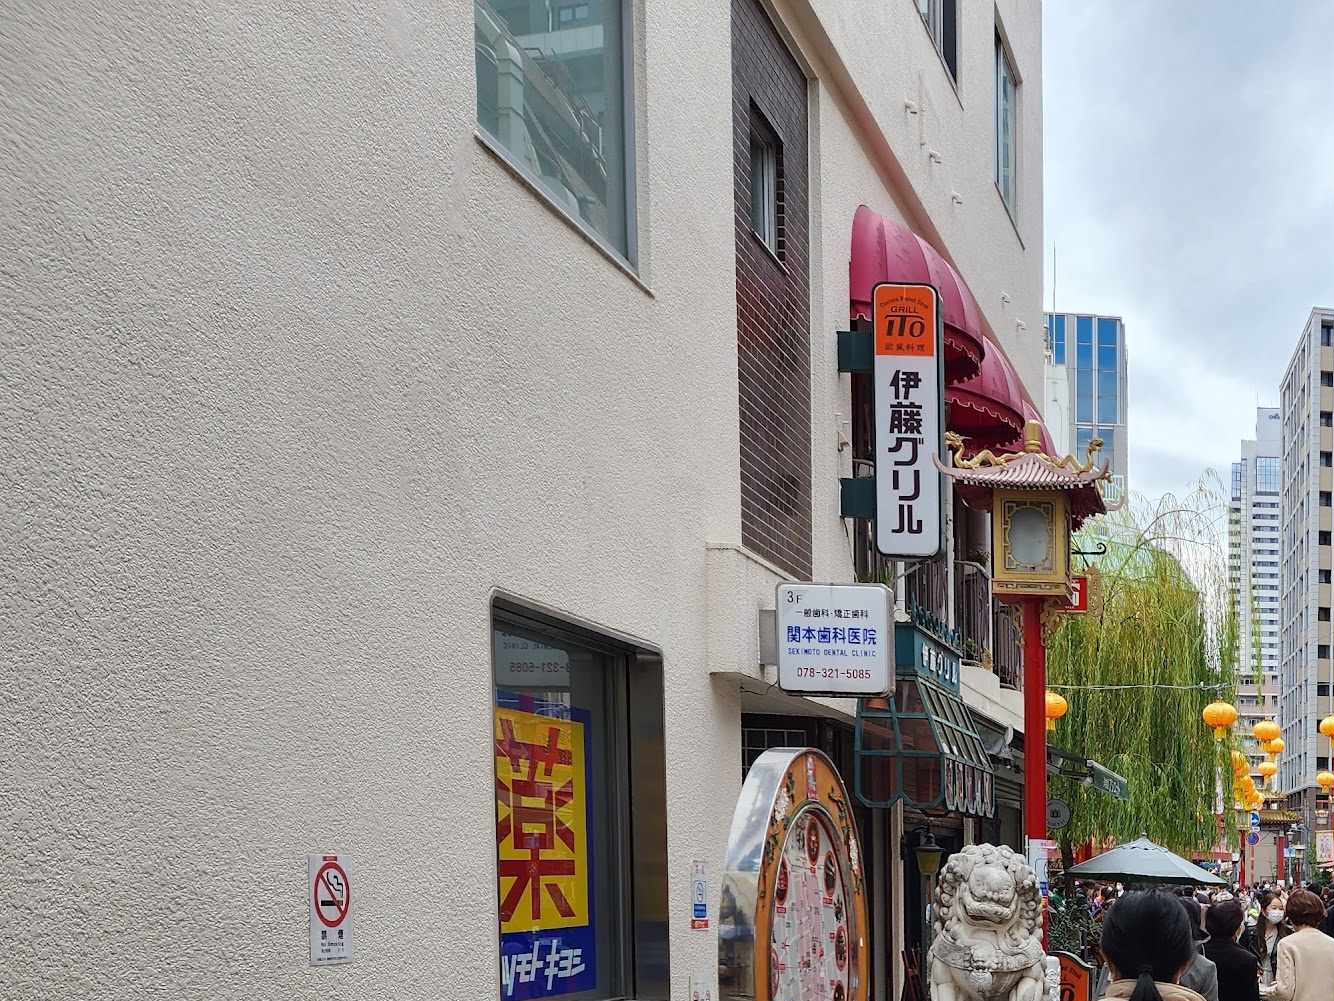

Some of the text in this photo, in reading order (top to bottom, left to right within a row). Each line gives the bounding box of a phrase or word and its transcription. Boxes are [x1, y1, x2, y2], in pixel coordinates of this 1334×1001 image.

[890, 305, 919, 314] GRILL
[884, 342, 926, 352] 欧風料理
[887, 368, 924, 536] 伊藤グリル
[787, 590, 803, 604] 3F
[787, 625, 877, 645] 関本歯科医院
[787, 647, 876, 658] SEKIMOTO DENTAL CLINIC
[796, 667, 871, 679] 078-321-5085
[495, 717, 576, 921] 薬
[501, 939, 586, 997] ツモトキヨシ
